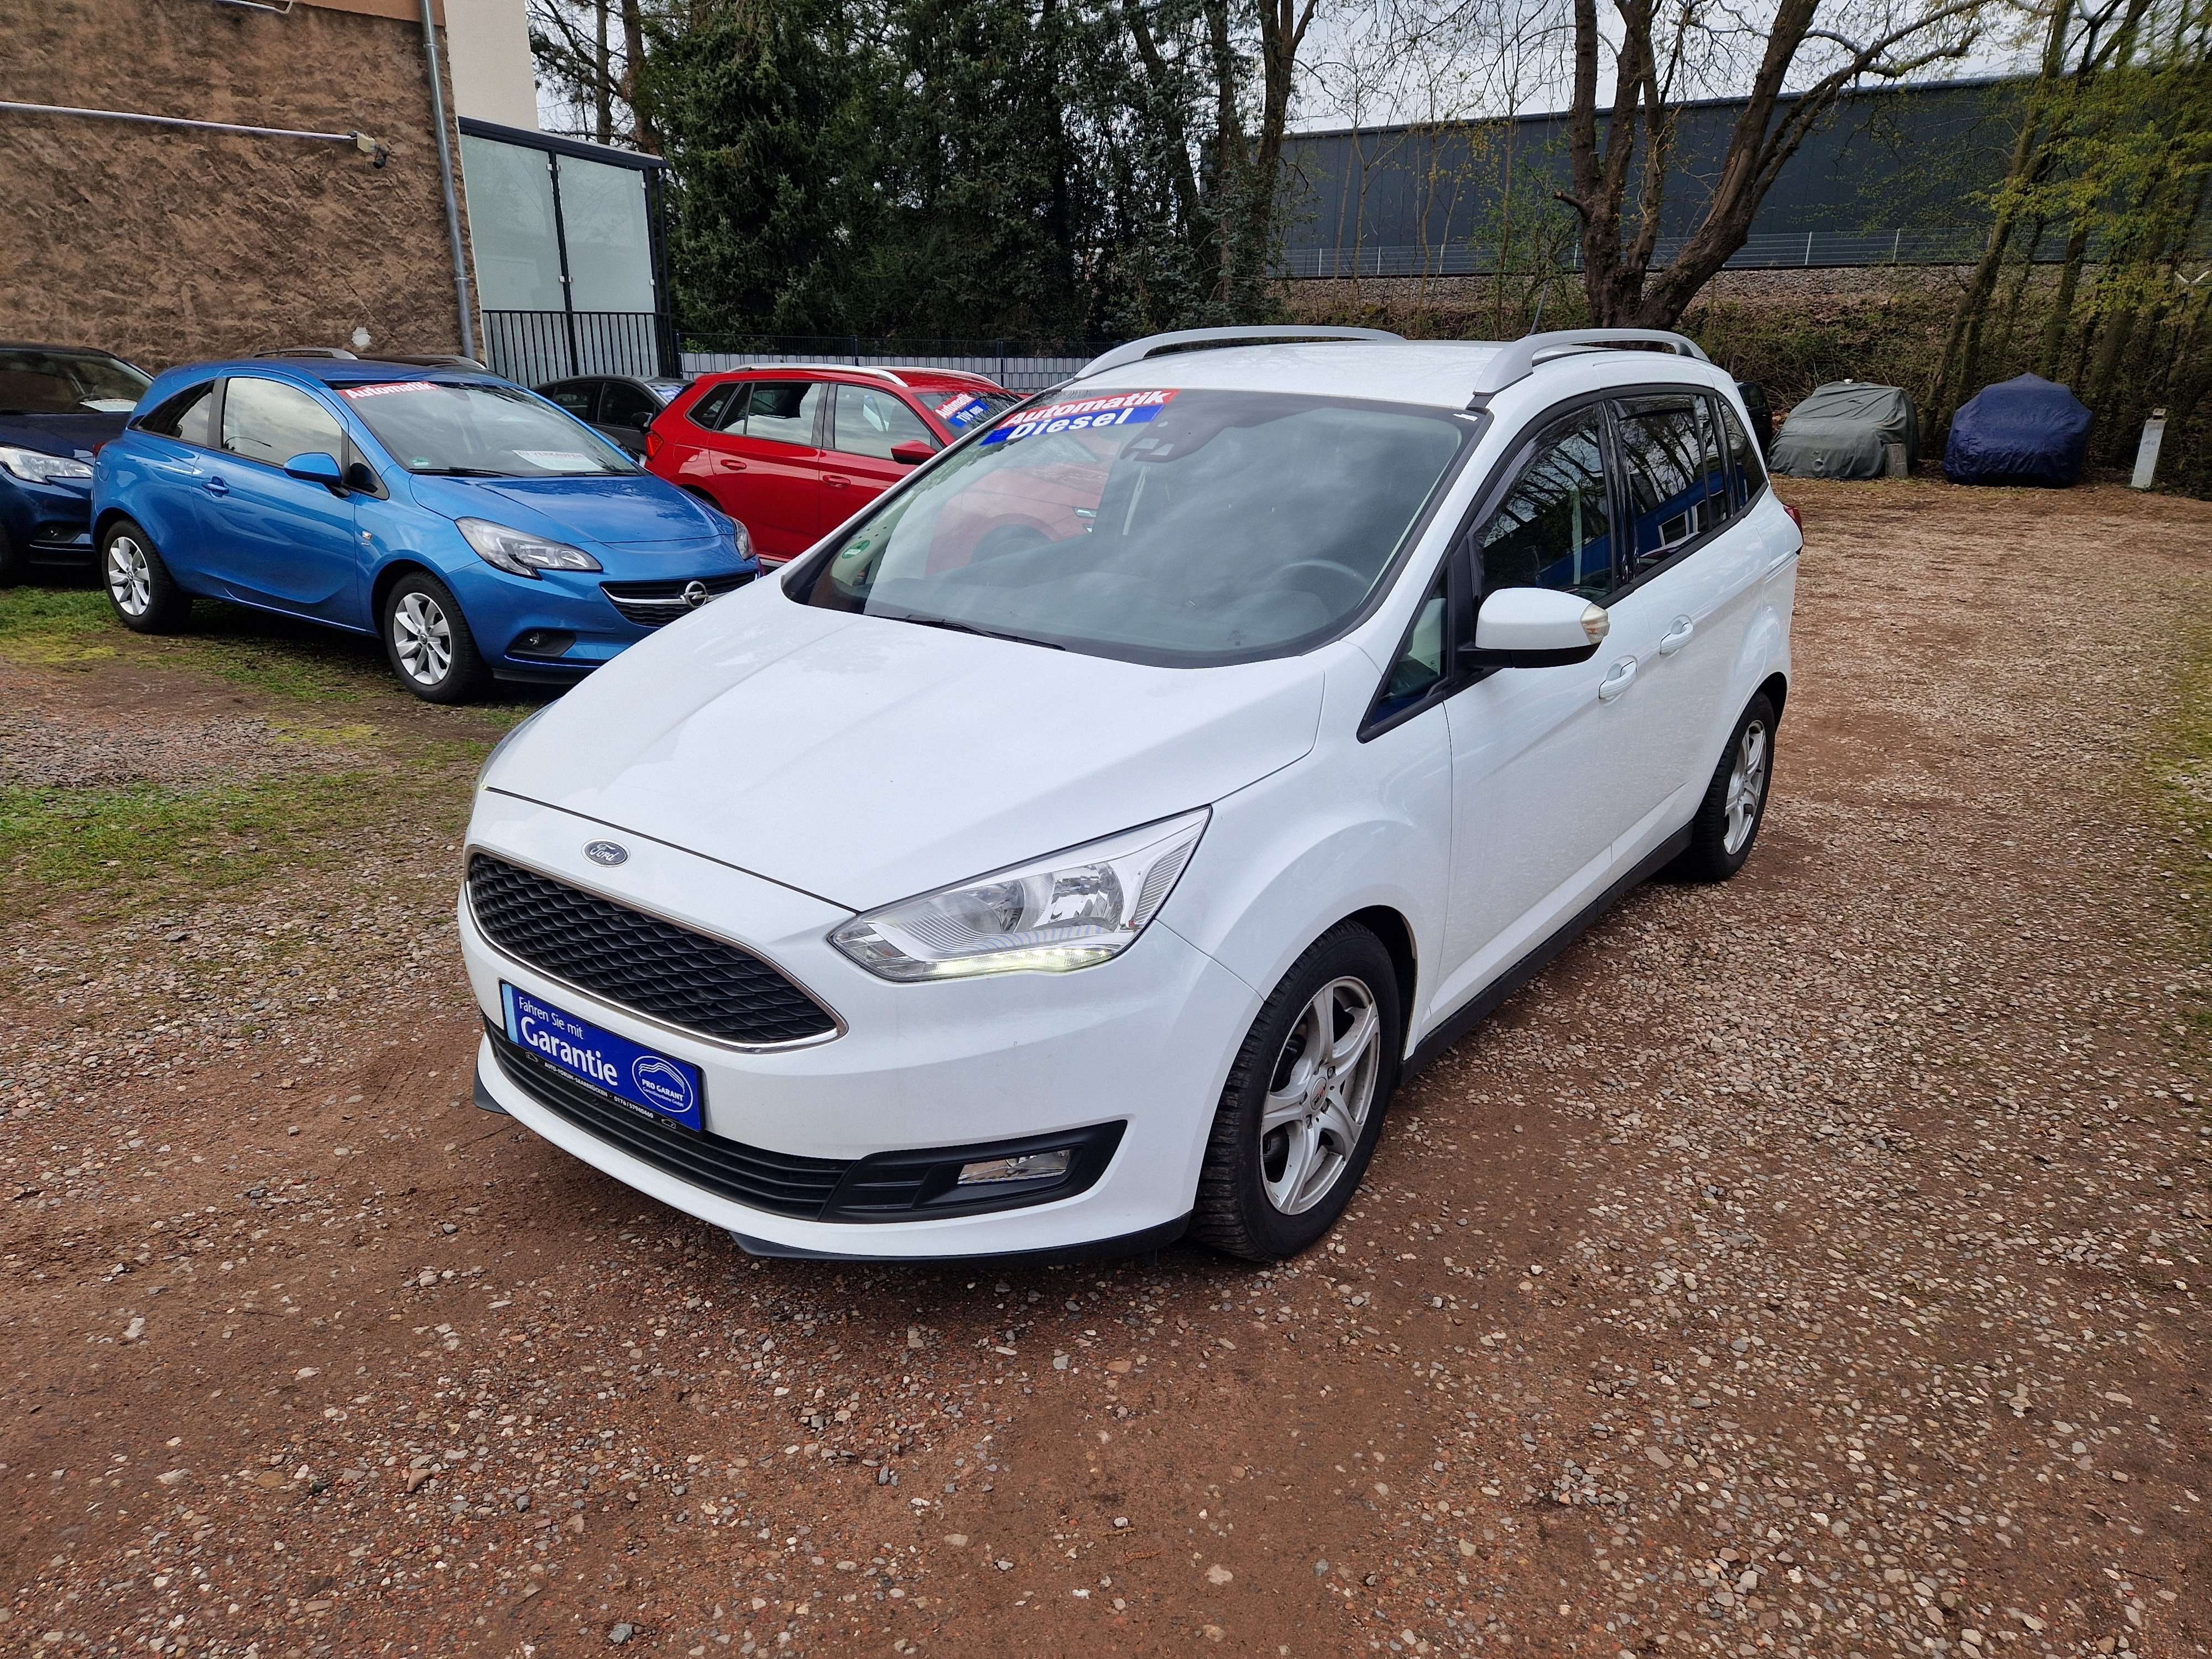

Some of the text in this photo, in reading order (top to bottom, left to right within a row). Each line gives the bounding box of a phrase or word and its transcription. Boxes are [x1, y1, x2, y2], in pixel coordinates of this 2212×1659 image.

[345, 382, 436, 399] Automatik
[935, 393, 974, 419] Automatik
[999, 390, 1171, 428] Automatik
[1006, 407, 1134, 440] Diesel
[589, 843, 619, 862] Ford
[519, 997, 585, 1040] Fahren Sie mit
[520, 1017, 619, 1086] Garantie
[641, 1078, 684, 1102] PRO GARANT
